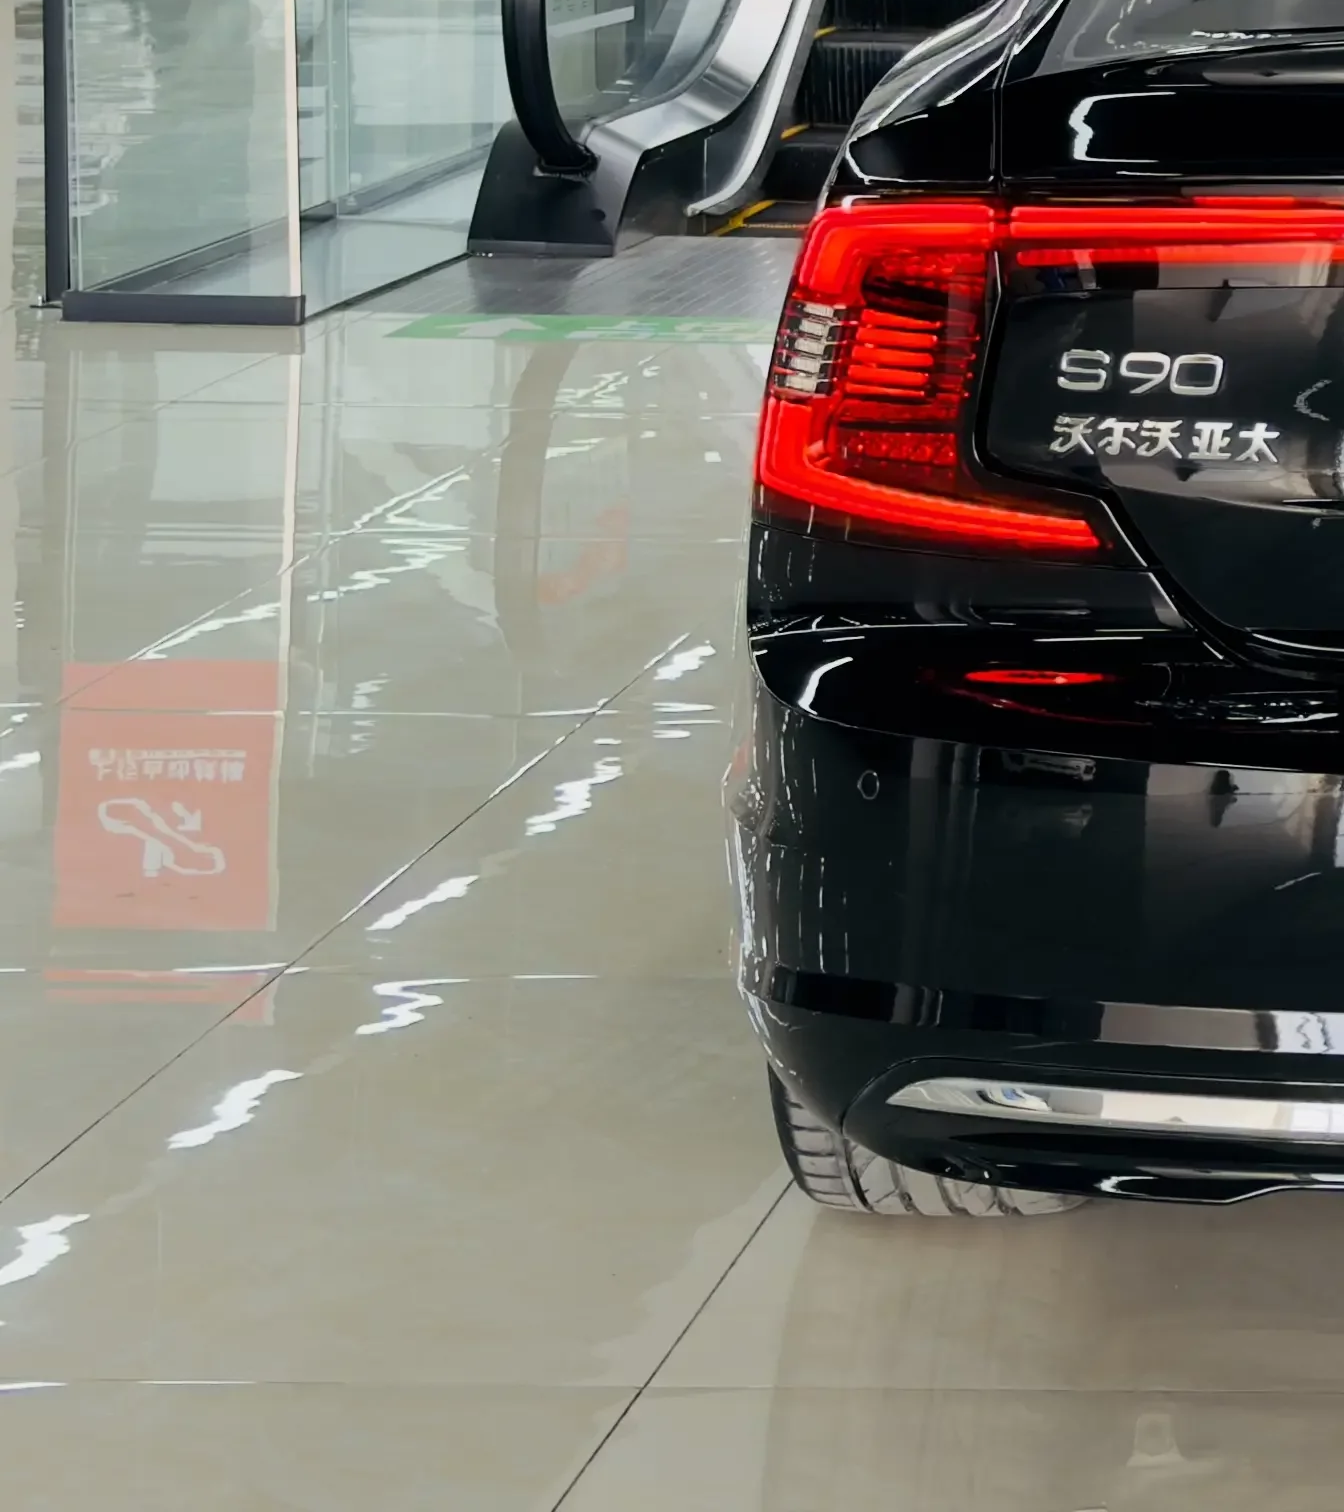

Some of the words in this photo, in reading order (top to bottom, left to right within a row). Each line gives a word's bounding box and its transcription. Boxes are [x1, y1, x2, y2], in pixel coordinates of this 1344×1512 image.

[1057, 348, 1224, 396] S90
[1049, 414, 1281, 463] 沃尔沃亚太
